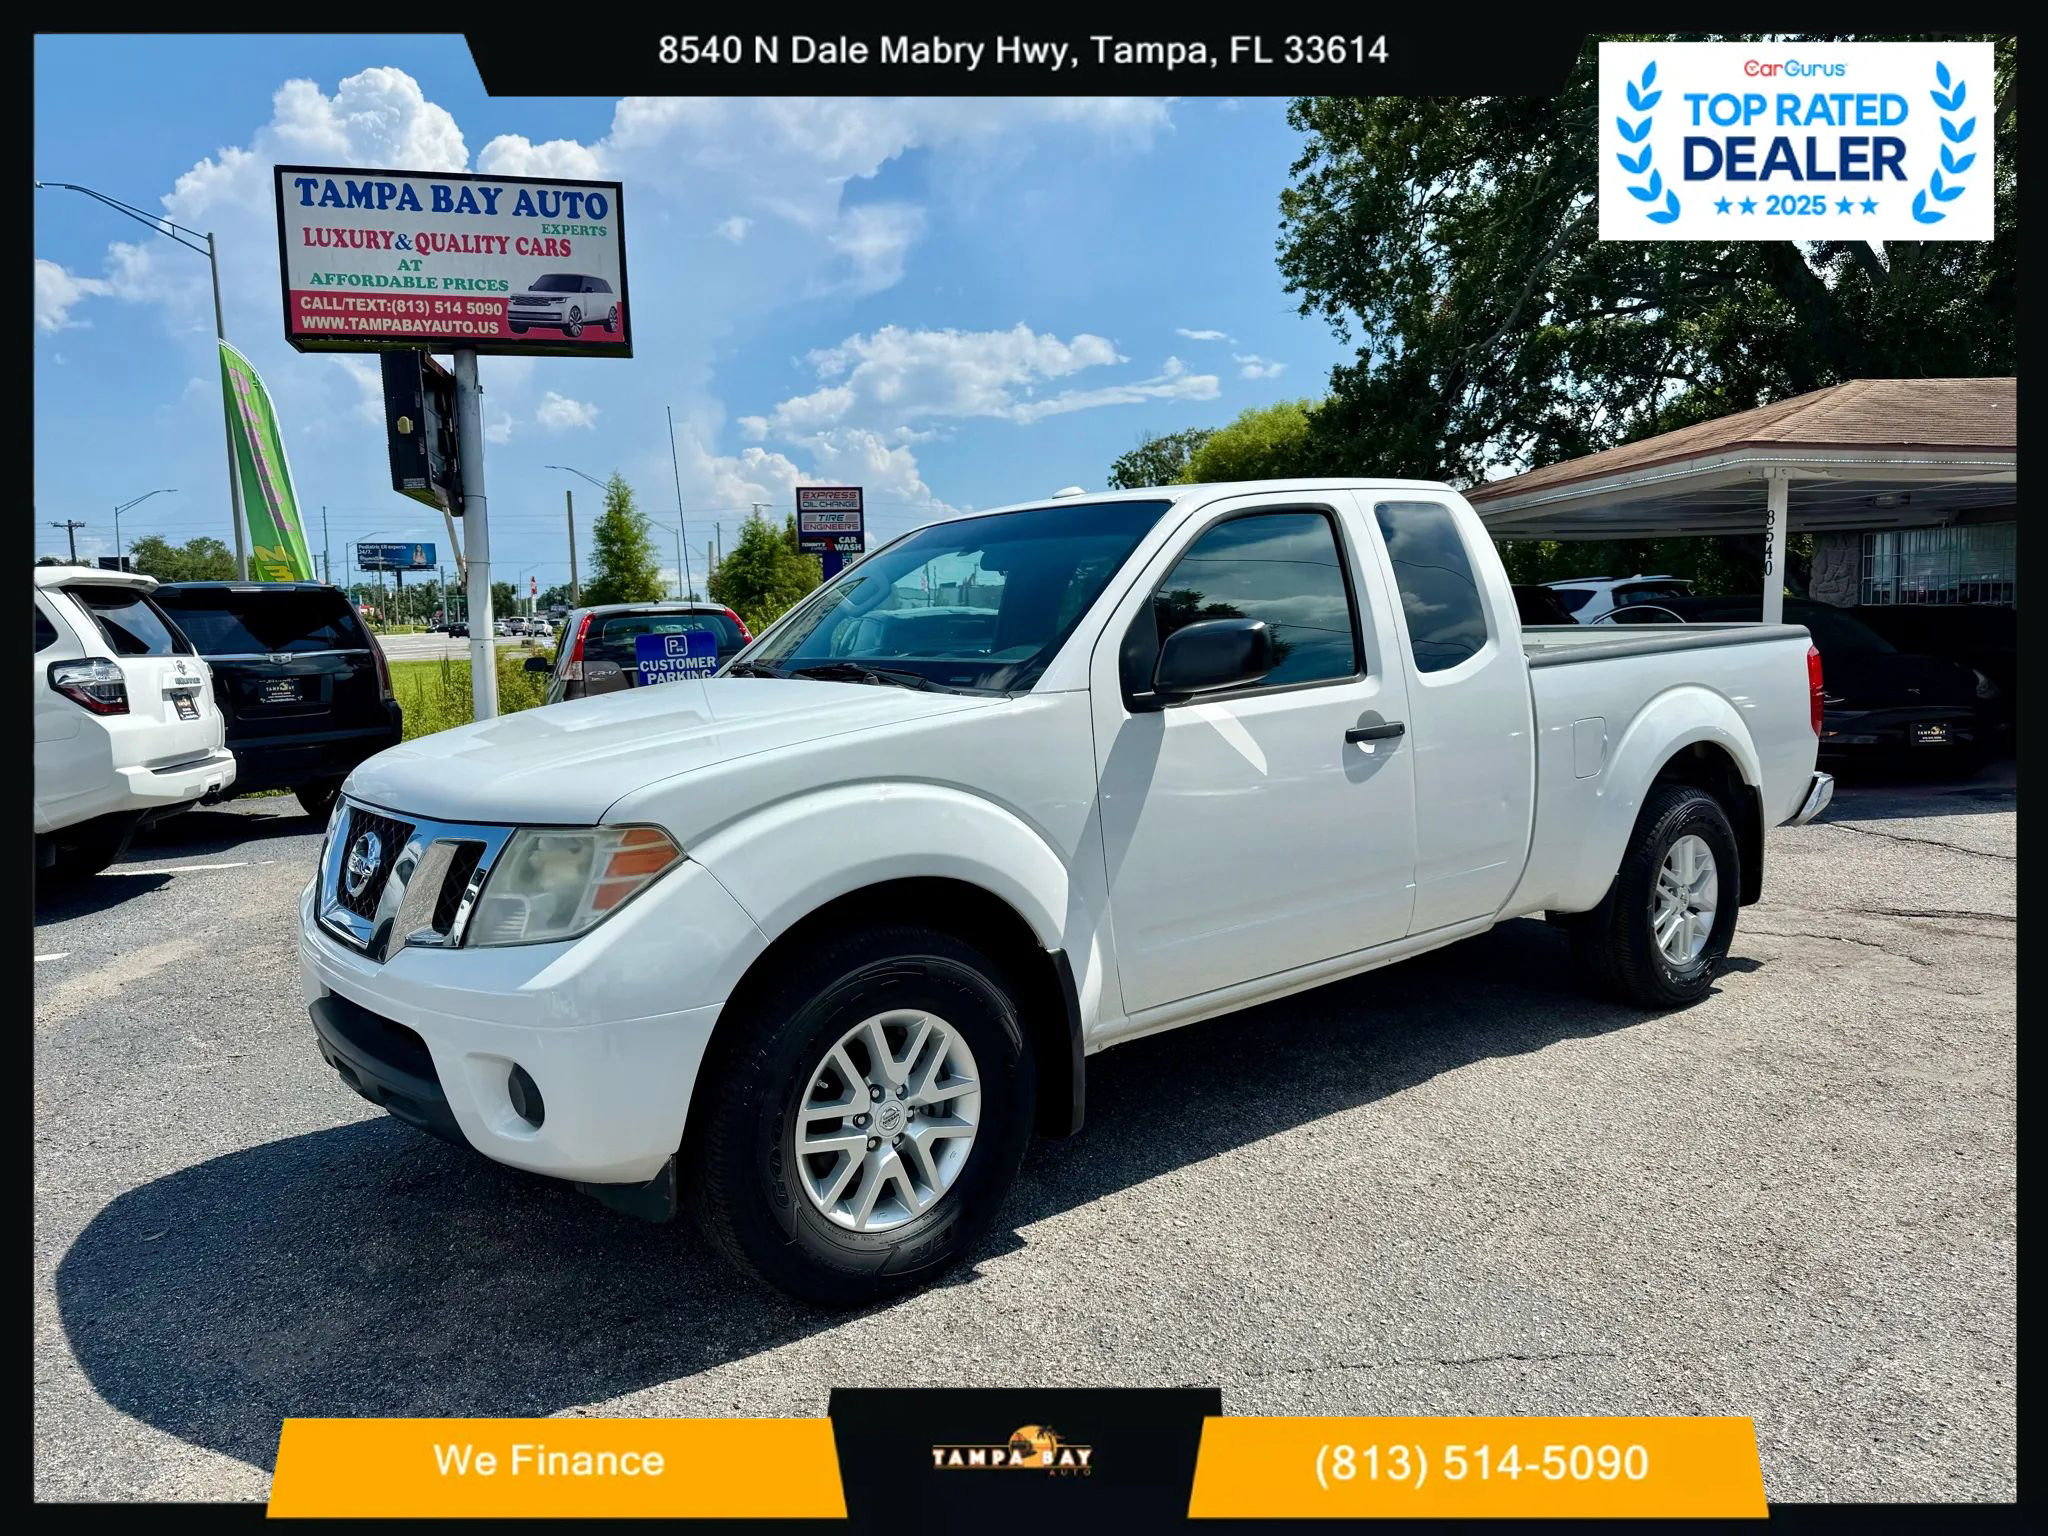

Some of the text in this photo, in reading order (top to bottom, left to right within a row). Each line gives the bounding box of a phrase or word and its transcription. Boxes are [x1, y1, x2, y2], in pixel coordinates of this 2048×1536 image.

[294, 177, 608, 220] TAMPA BAY AUTO
[541, 223, 608, 237] EXPERTS
[515, 237, 572, 257] CARS
[397, 258, 423, 272] AT
[309, 272, 510, 292] AFFORDABLE PRICES
[434, 301, 463, 314] 514
[466, 302, 503, 316] 5090
[301, 315, 500, 335] WWW.TAMPABAYAUTO.US
[802, 491, 857, 499] EXPRESS
[818, 514, 845, 522] TIRE
[803, 523, 859, 531] ENGINEERS
[834, 543, 862, 551] WASH
[838, 536, 857, 544] CAR
[1765, 509, 1775, 577] 8540
[639, 656, 717, 672] CUSTOMER
[647, 669, 712, 685] PARKING
